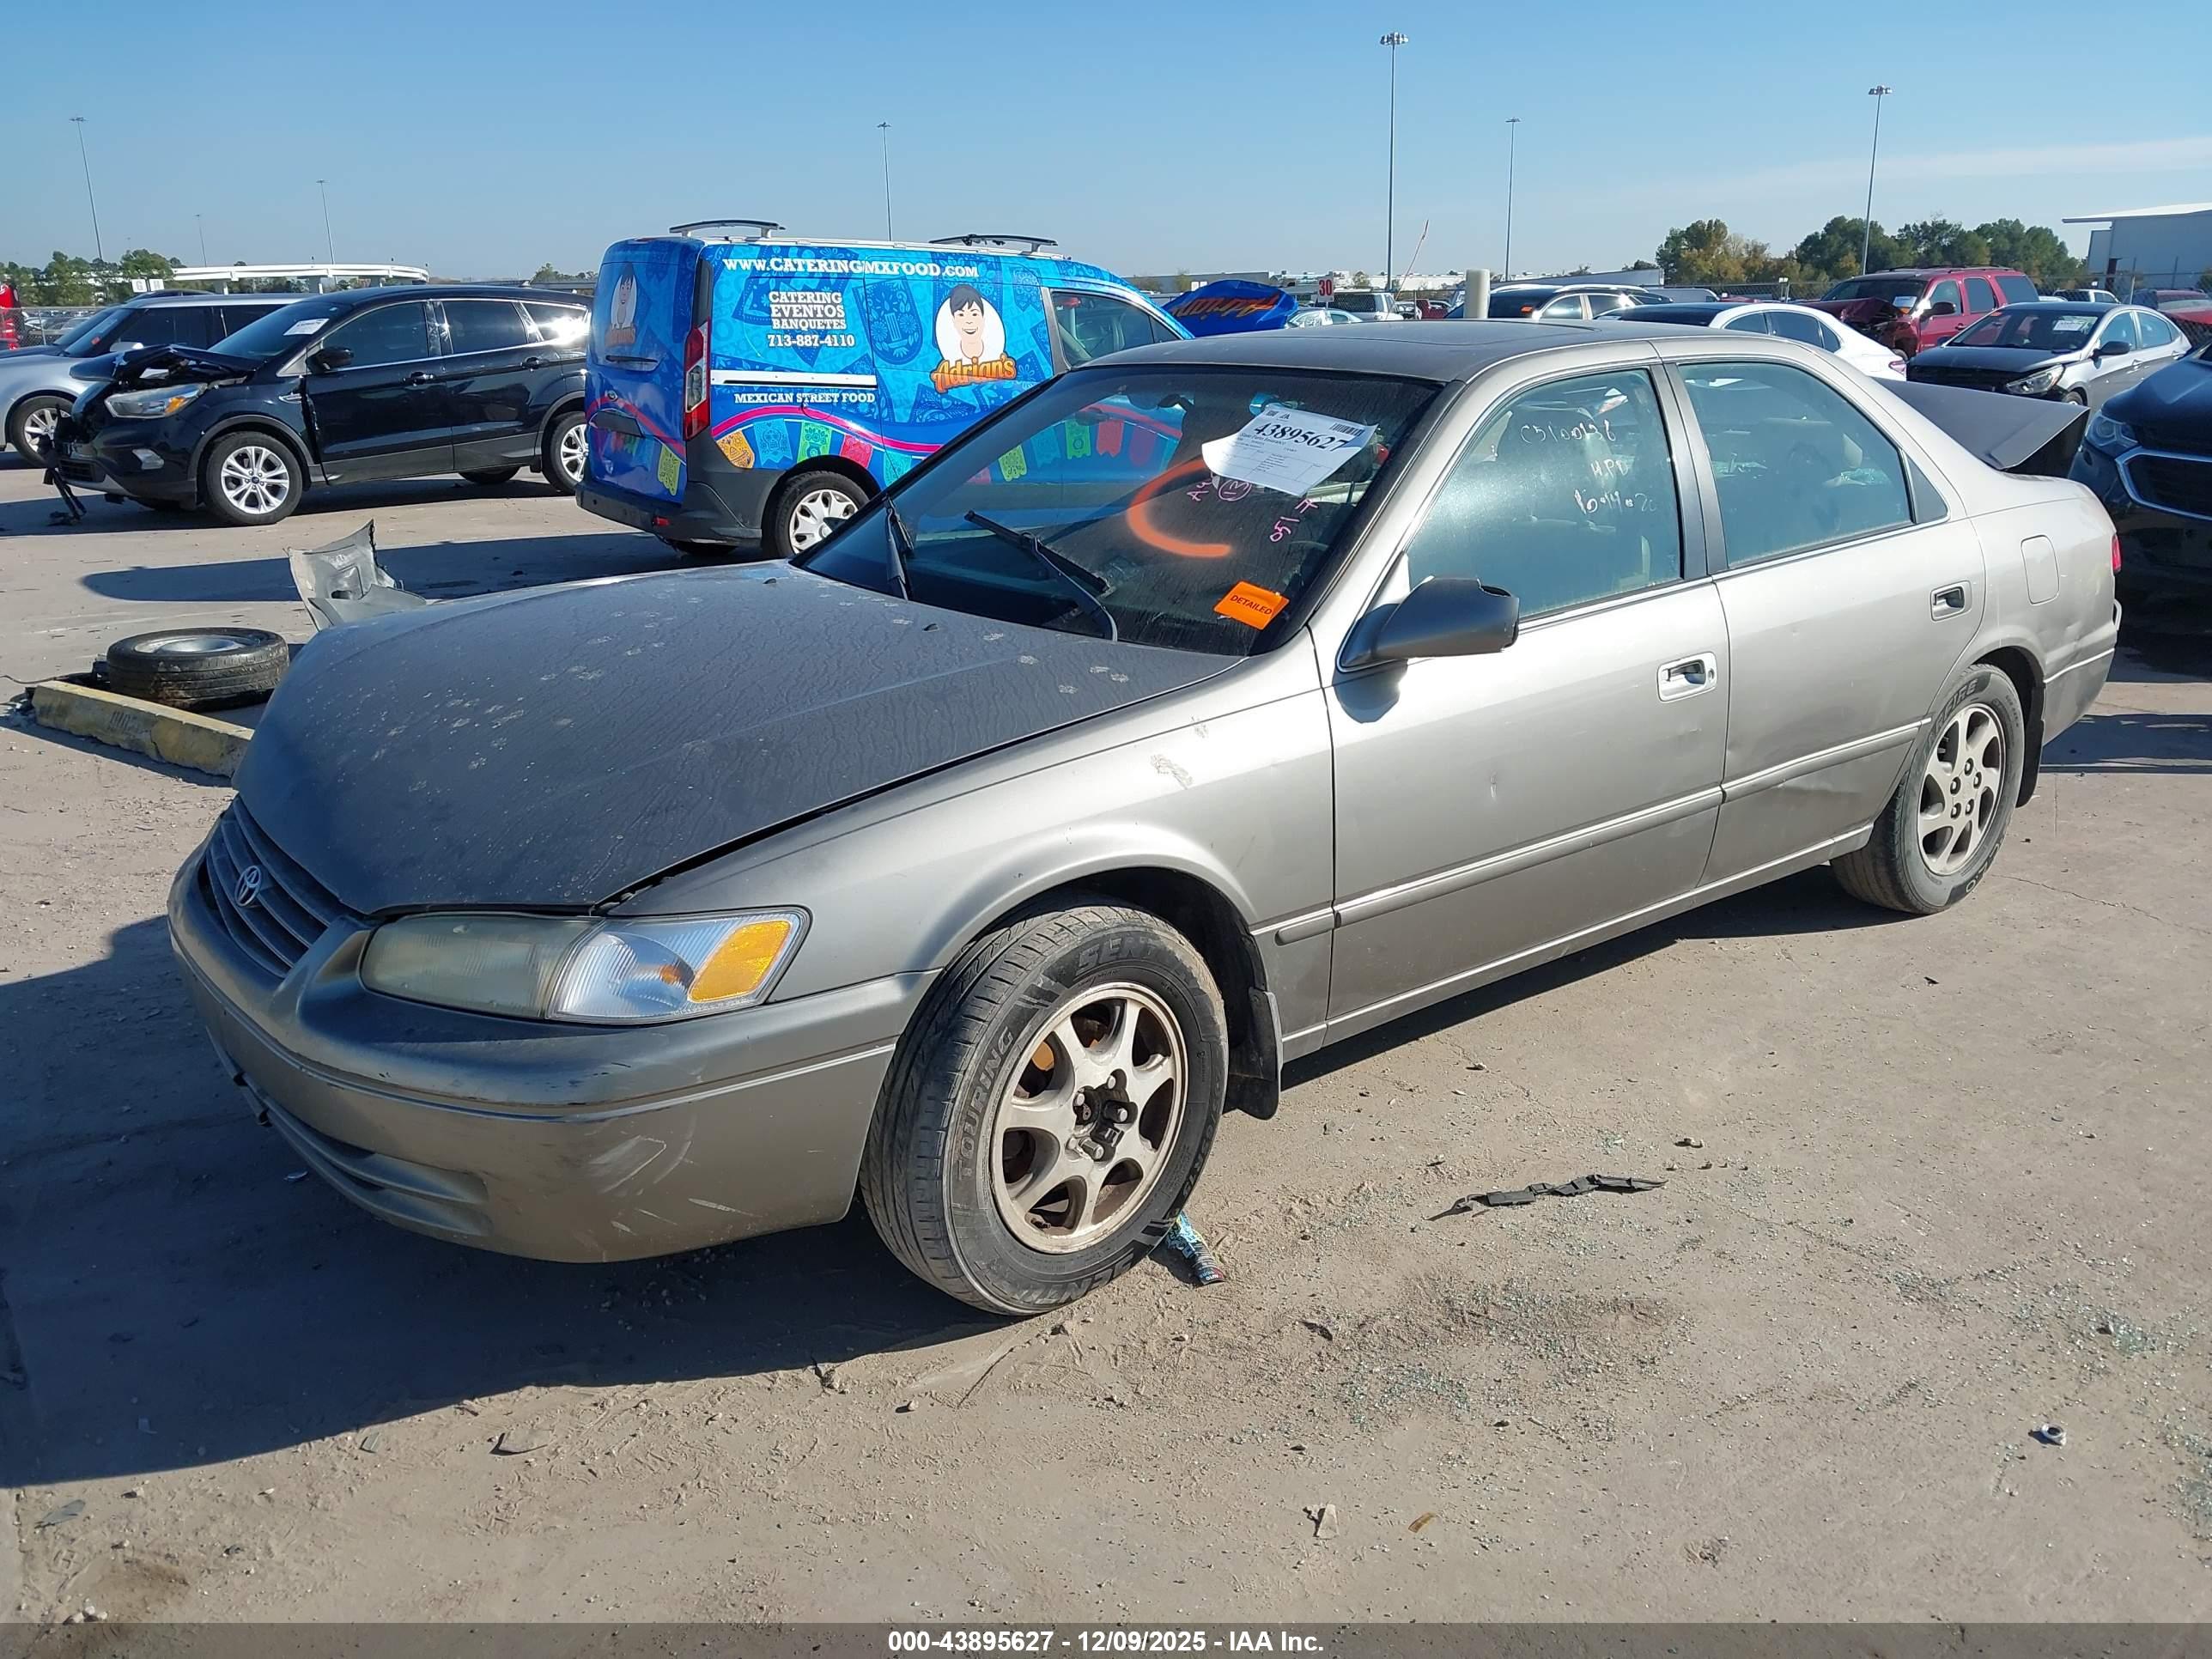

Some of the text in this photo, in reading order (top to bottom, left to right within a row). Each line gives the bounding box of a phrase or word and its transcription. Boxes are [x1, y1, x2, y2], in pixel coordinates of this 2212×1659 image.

[1319, 279, 1332, 296] 30
[769, 292, 842, 304] CATERING
[770, 304, 845, 318] EVENTOS
[772, 319, 847, 331] BANQUETES
[768, 334, 855, 347] 713-887-4110
[931, 352, 1016, 392] Adrian's
[735, 393, 875, 404] MEXICAN STREET FOOD
[1255, 422, 1350, 452] 43895627
[1231, 594, 1273, 615] DETAILED
[957, 1025, 1014, 1182] TOURING
